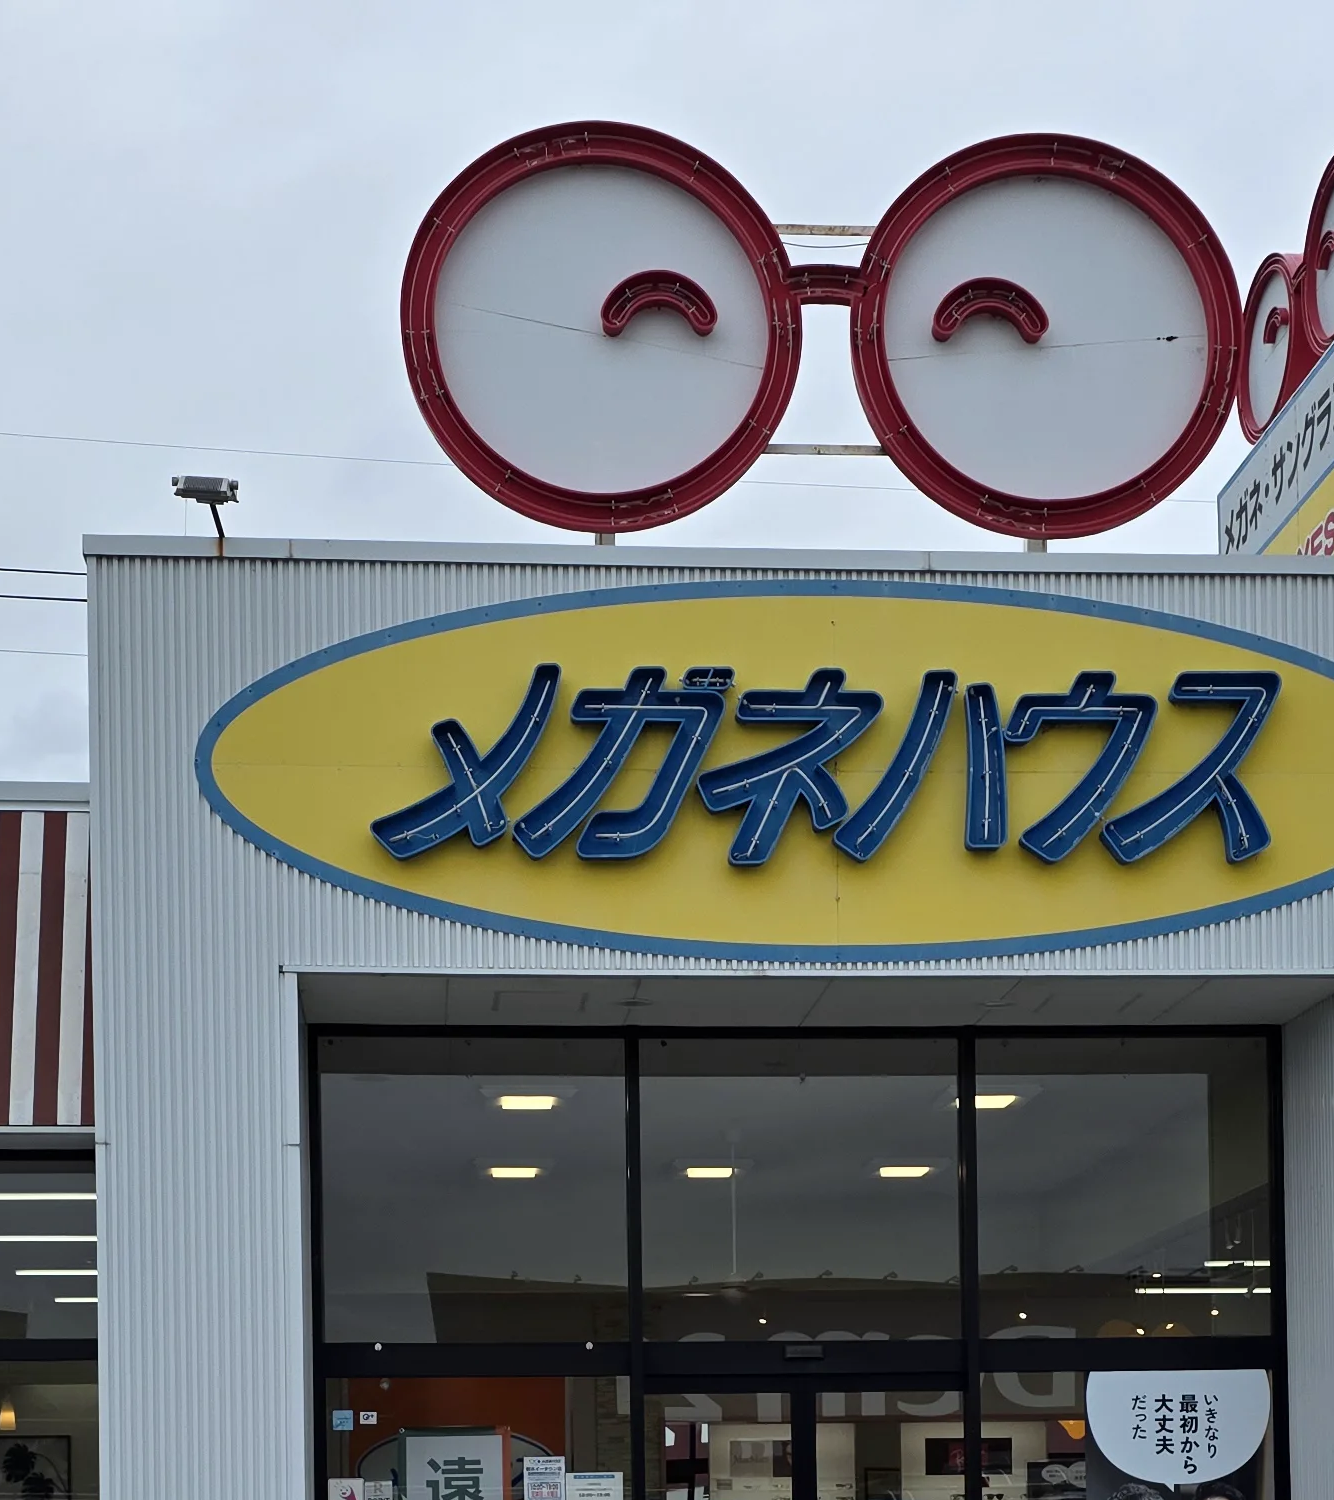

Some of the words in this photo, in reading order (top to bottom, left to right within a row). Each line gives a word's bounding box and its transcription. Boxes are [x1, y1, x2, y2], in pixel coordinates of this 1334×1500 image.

[370, 662, 1282, 867] メガネハウス
[1131, 1394, 1148, 1440] だった
[1154, 1394, 1174, 1455] 大丈夫
[1179, 1394, 1199, 1475] 最初から
[1204, 1394, 1219, 1459] いきなり
